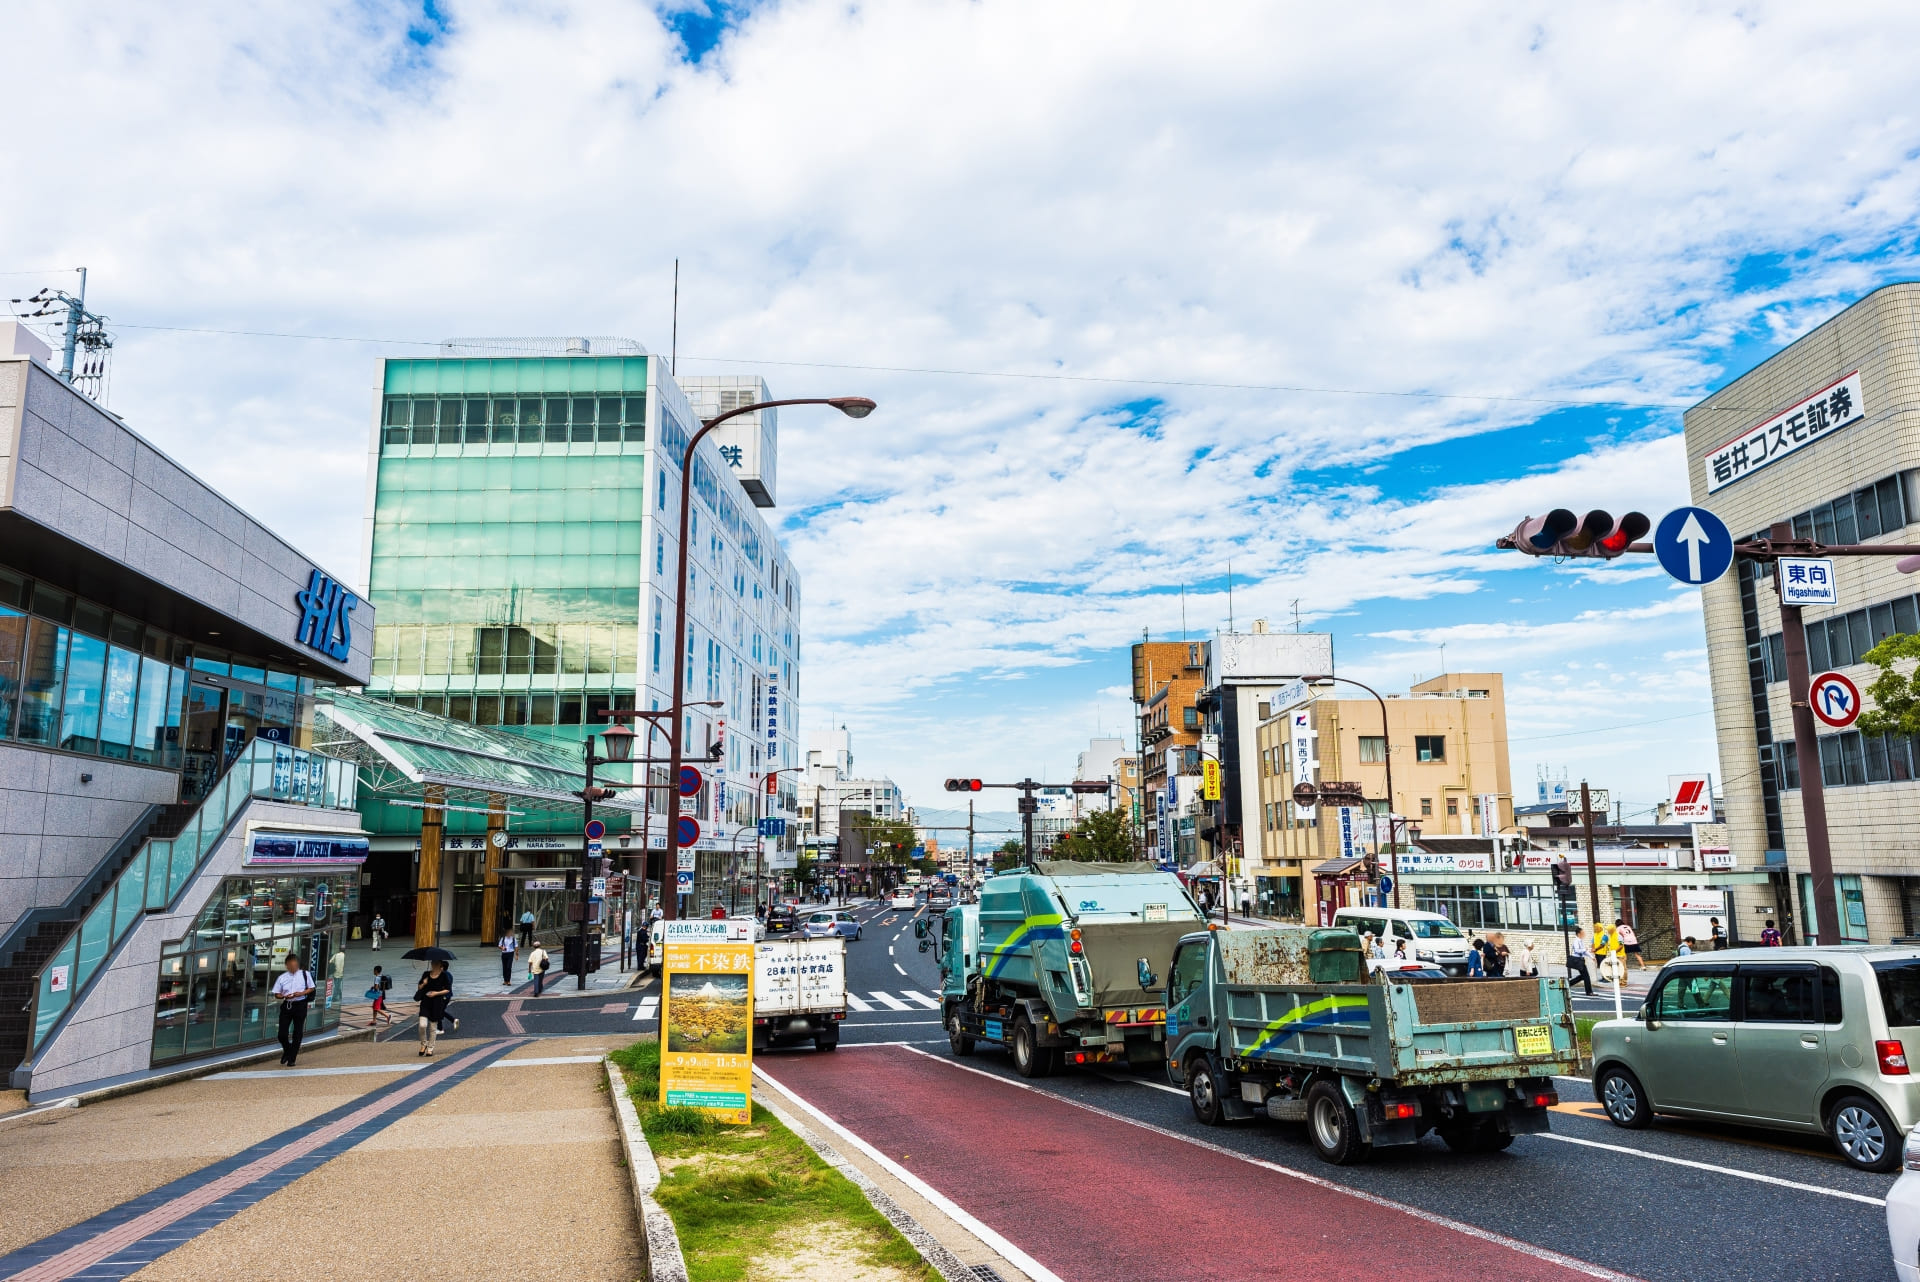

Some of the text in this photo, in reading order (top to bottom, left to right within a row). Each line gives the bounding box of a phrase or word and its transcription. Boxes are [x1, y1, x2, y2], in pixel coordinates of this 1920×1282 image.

[1713, 386, 1853, 483] 岩井コスモ証券
[719, 445, 742, 468] 鉄
[1787, 565, 1827, 585] 東向
[1787, 587, 1831, 599] Higashimuki
[767, 685, 778, 738] 近鉄奈良駅
[1674, 804, 1709, 812] NIPPON
[296, 841, 331, 857] LAWSON
[1458, 860, 1484, 868] のりば
[667, 923, 727, 934] 奈良県立美術館
[693, 952, 751, 971] 不染鉄
[1517, 1027, 1548, 1037] お先にどうぞ
